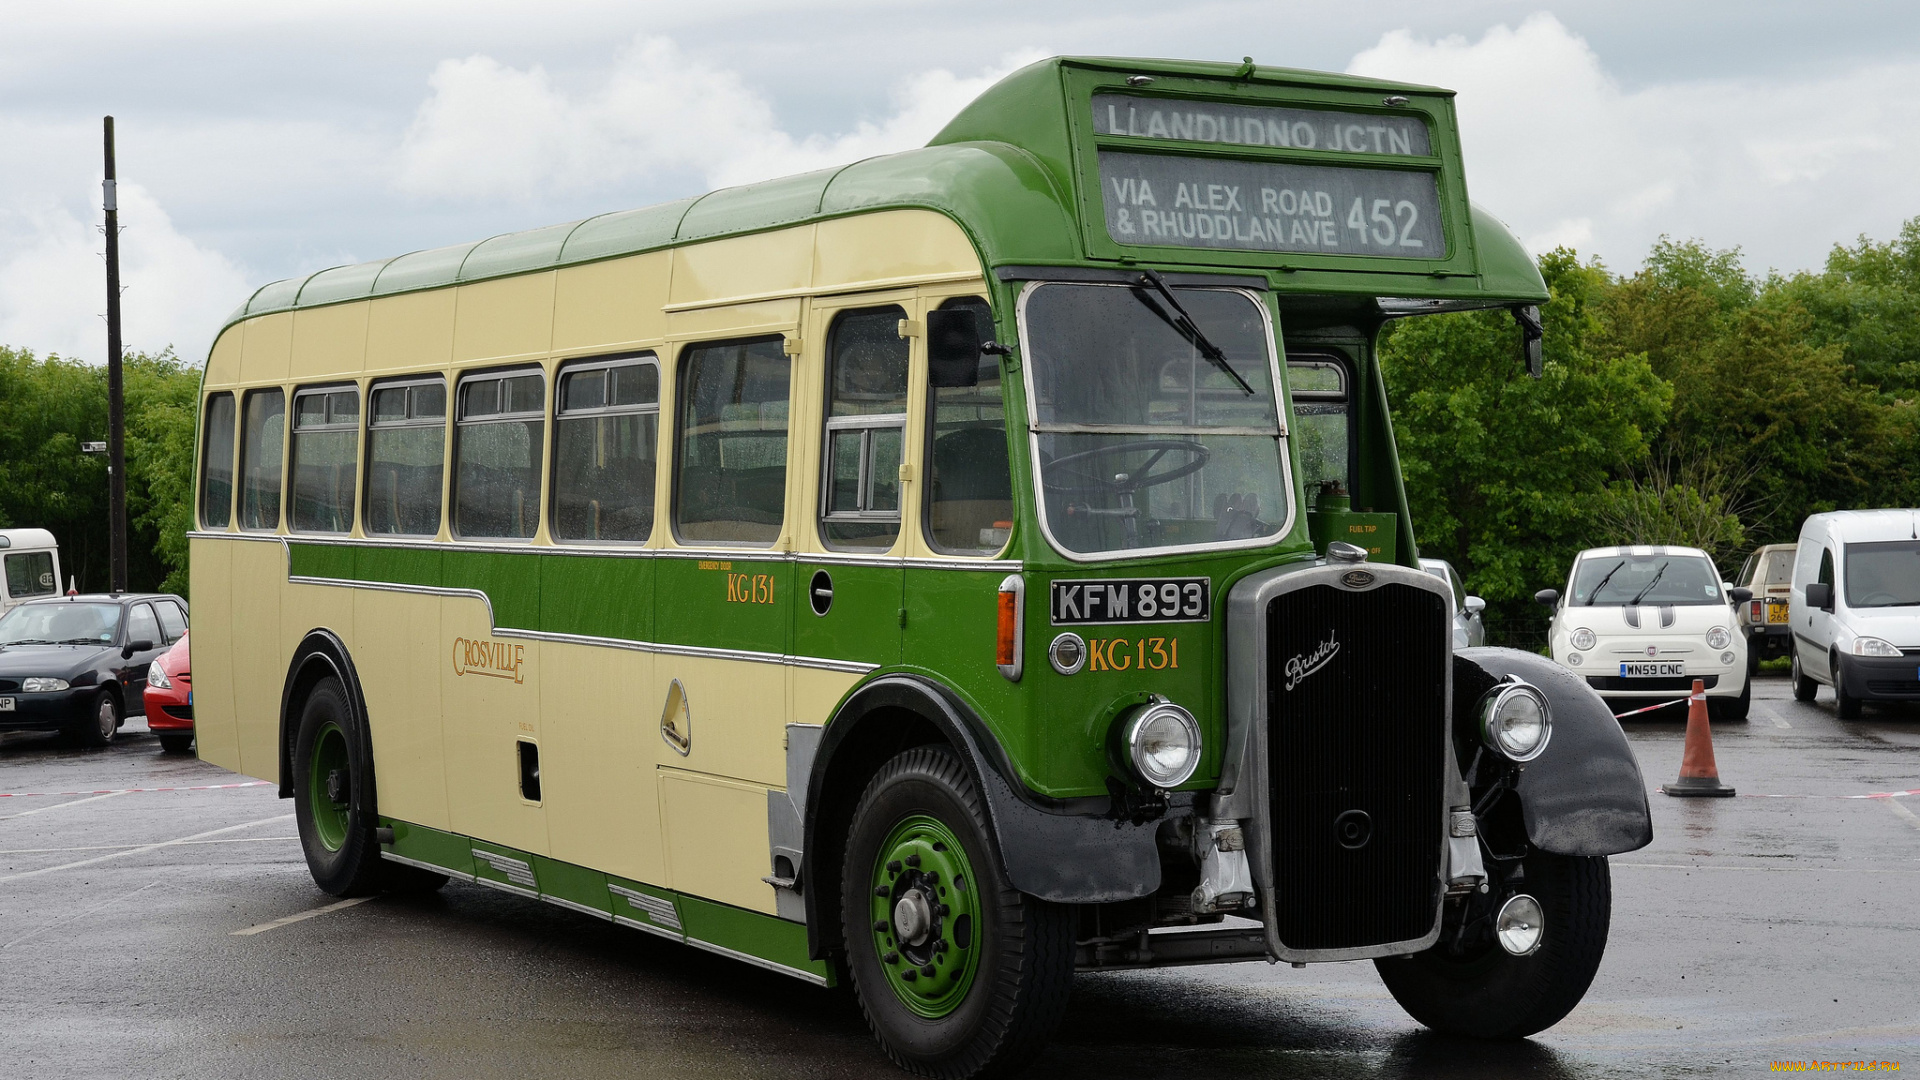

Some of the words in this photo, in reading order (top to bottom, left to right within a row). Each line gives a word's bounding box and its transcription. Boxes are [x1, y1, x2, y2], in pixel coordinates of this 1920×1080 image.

[1108, 105, 1316, 150] LLANDUDNO
[1327, 124, 1412, 155] JCTN
[1111, 177, 1156, 207] VIA
[1175, 182, 1242, 211] ALEX
[1261, 188, 1332, 217] ROAD
[1117, 208, 1136, 235] &
[1141, 210, 1286, 244] RHUDDLAN
[1290, 219, 1338, 246] AVE
[1348, 197, 1423, 247] 452
[1349, 525, 1363, 533] FUEL
[1059, 584, 1129, 619] KFM
[1137, 583, 1203, 617] 893
[1284, 629, 1340, 691] Bristol
[1627, 664, 1657, 675] WN59
[1660, 664, 1683, 675] CNC
